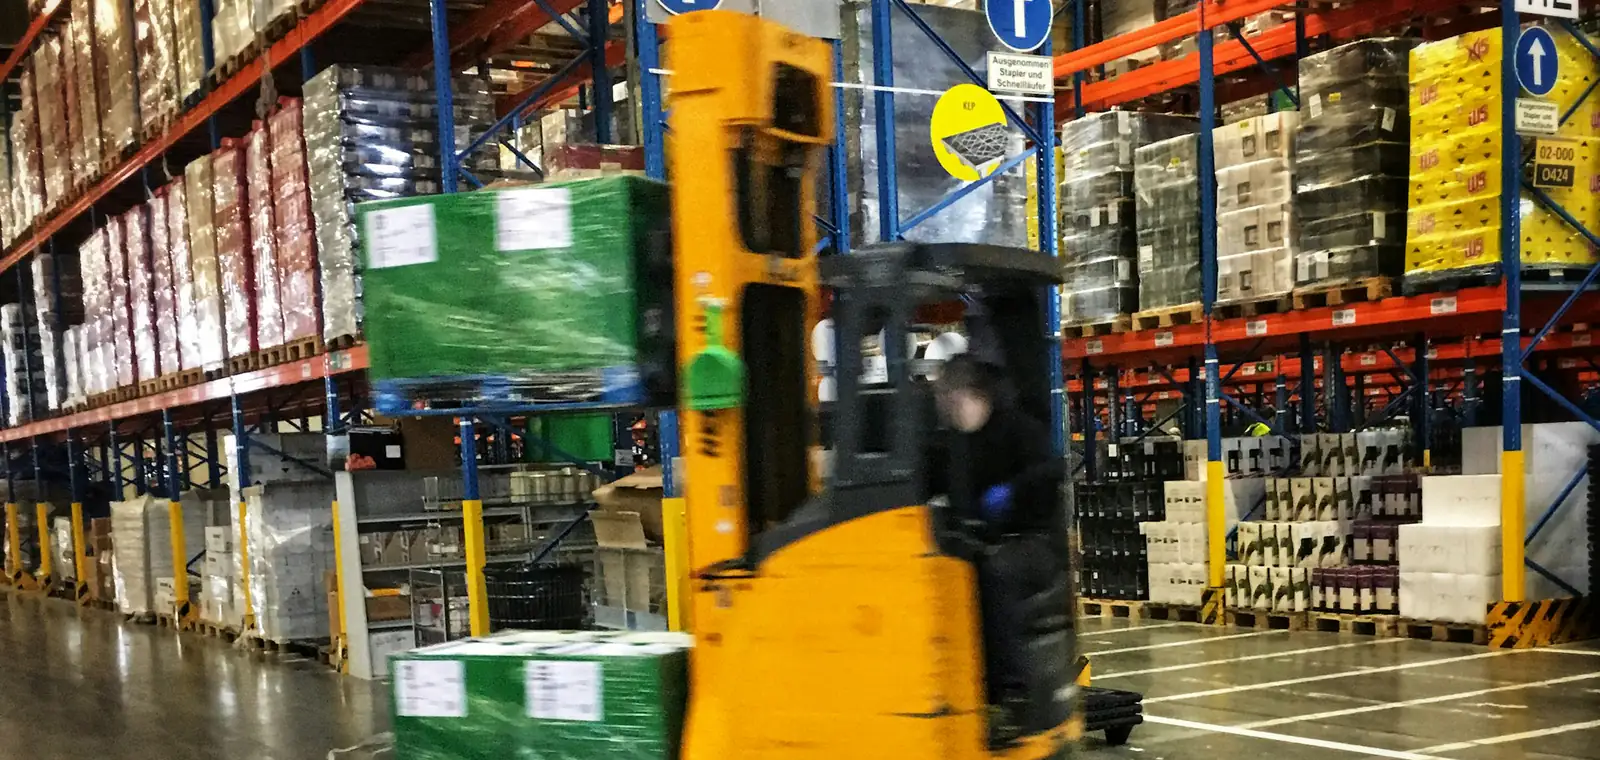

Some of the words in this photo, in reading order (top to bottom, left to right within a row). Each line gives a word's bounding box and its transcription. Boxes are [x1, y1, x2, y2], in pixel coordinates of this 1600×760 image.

[992, 56, 1049, 68] Ausgenommen
[999, 68, 1026, 78] Stapler
[1028, 71, 1043, 79] und
[1539, 145, 1575, 161] 02-000
